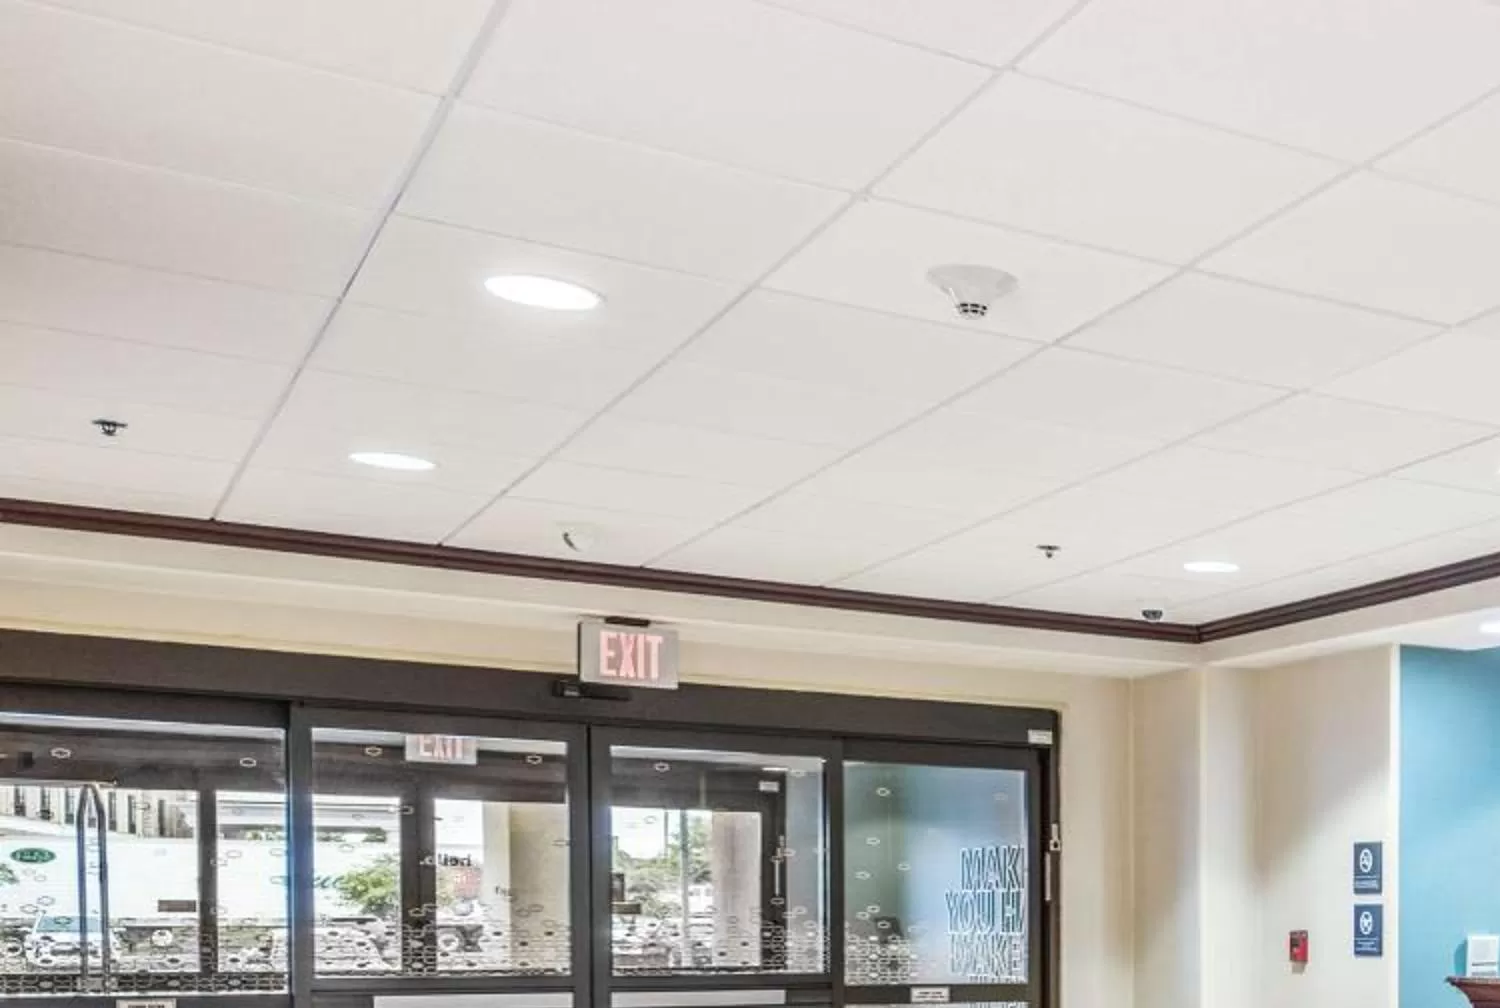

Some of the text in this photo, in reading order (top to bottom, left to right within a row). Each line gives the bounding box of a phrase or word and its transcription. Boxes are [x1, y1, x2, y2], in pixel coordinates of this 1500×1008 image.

[600, 631, 663, 680] EXIT
[960, 846, 1025, 891] MAK
[945, 889, 1025, 934] YOU H
